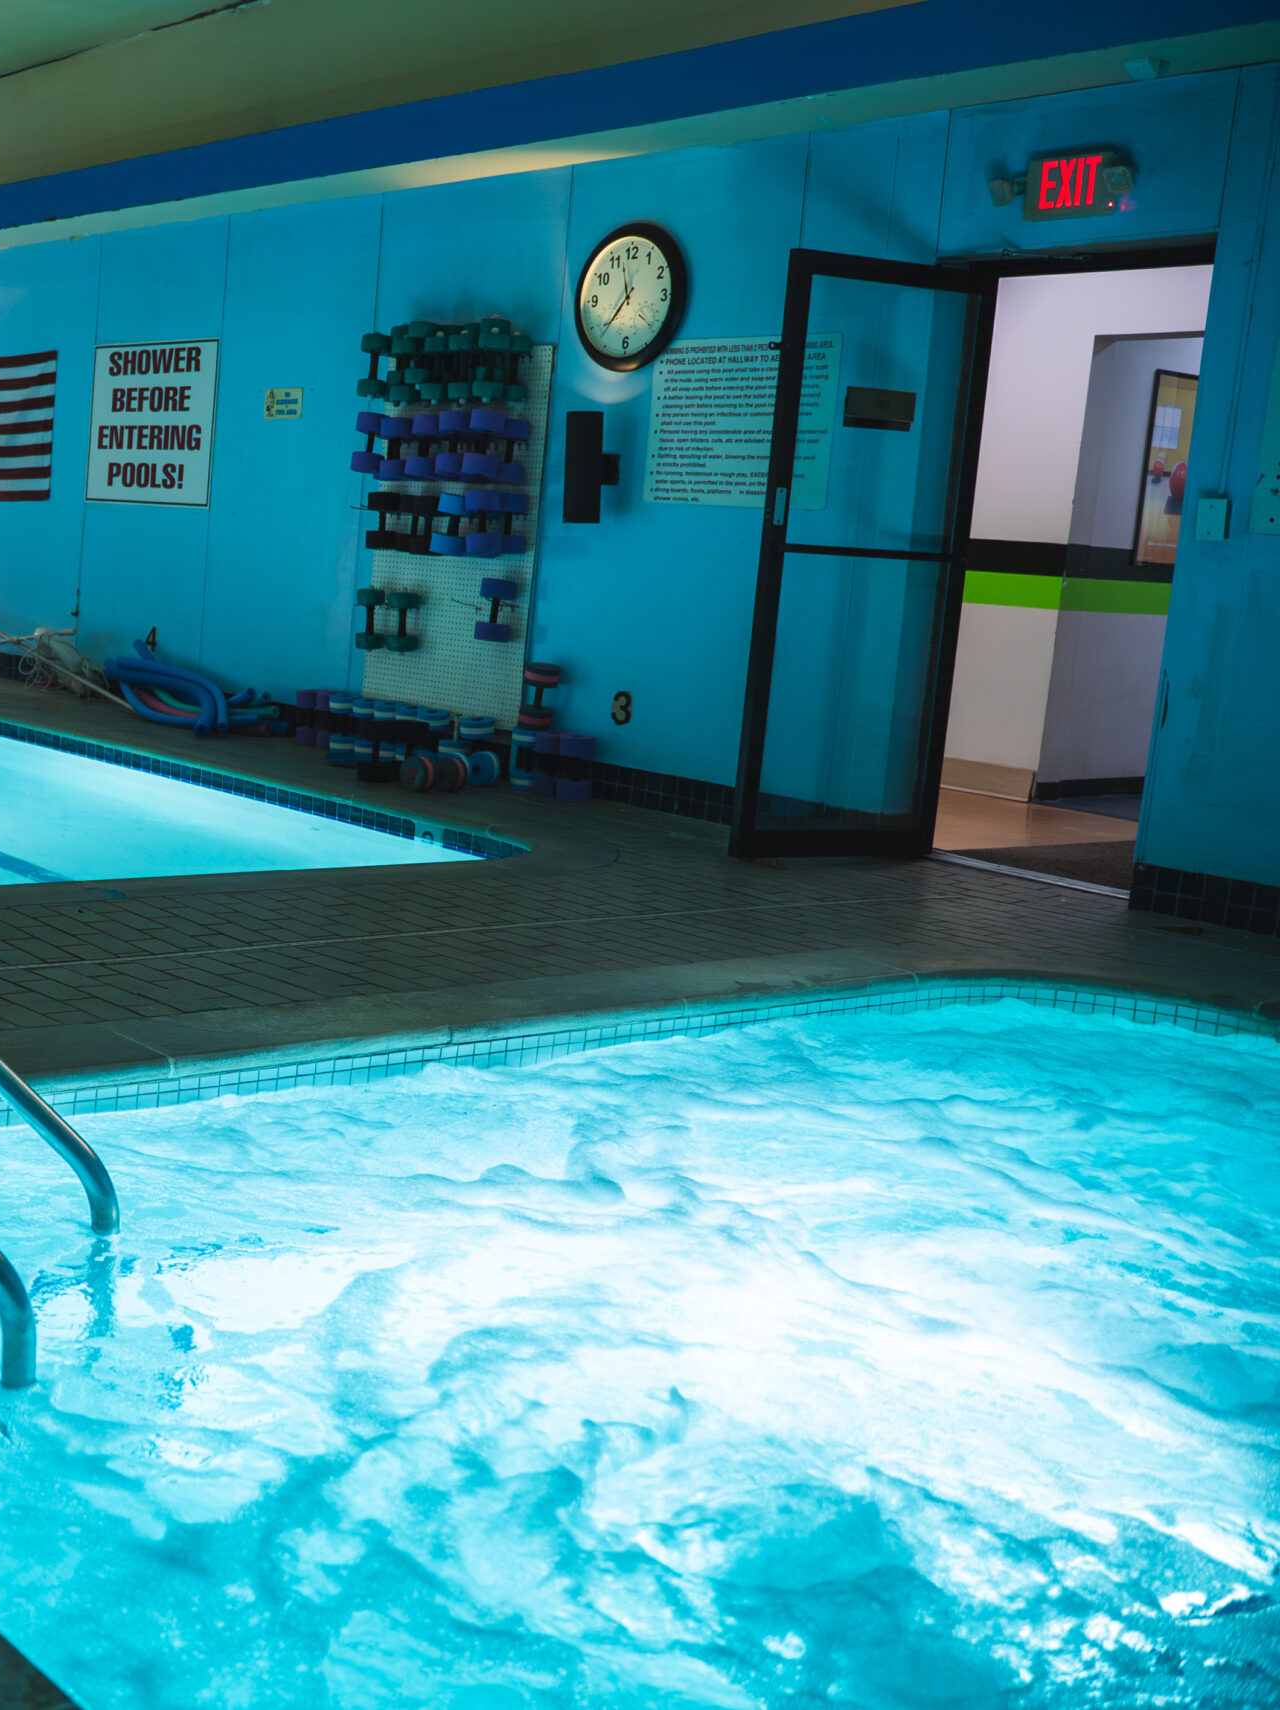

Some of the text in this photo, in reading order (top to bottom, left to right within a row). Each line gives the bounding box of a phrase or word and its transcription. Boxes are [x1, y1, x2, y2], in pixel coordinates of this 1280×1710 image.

[1038, 155, 1102, 210] EXIT
[625, 246, 639, 260] 12
[646, 251, 652, 265] 1
[609, 255, 621, 269] 11
[596, 272, 610, 286] 10
[657, 266, 665, 279] 2
[591, 295, 599, 308] 9
[660, 288, 668, 302] 3
[621, 336, 630, 350] 6
[689, 345, 716, 353] PROHIBITED
[109, 346, 202, 376] SHOWER
[665, 357, 687, 365] PHONE
[687, 356, 717, 364] LOCATED
[726, 355, 759, 363] HALLWAY
[806, 352, 826, 360] AREA
[111, 386, 191, 413] BEFORE
[97, 424, 202, 451] ENTERING
[107, 462, 185, 490] POOLS!
[146, 626, 157, 652] 4
[611, 690, 632, 726] 3
